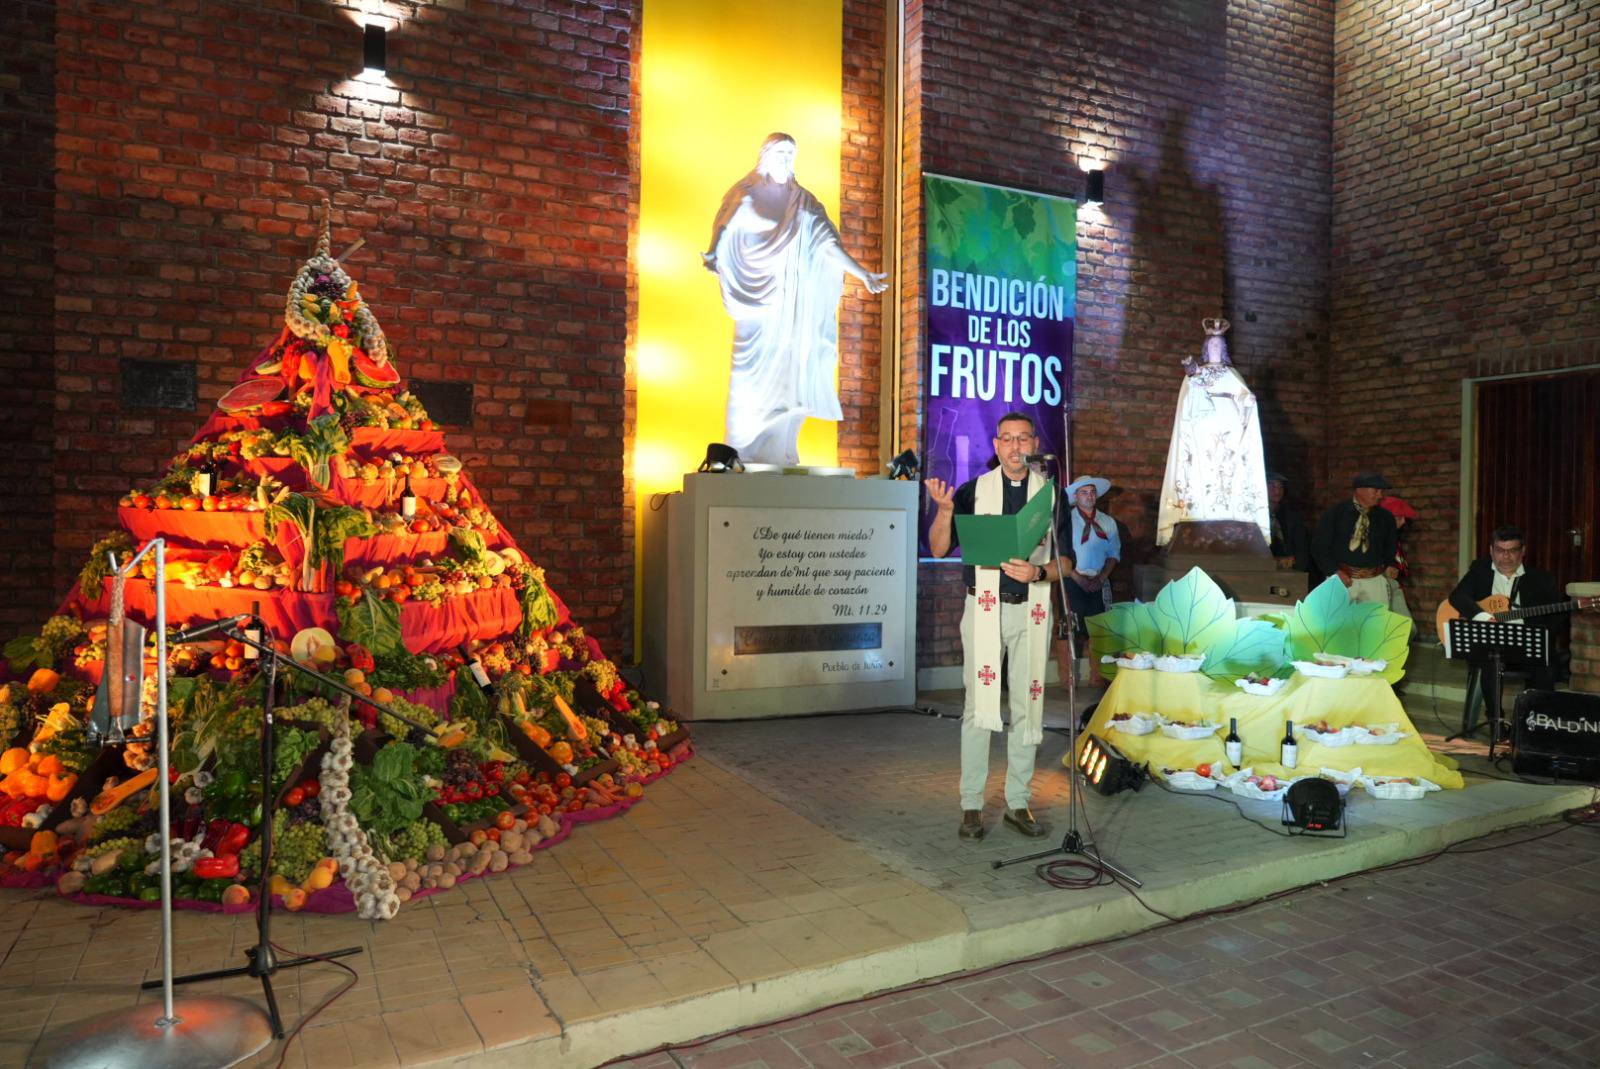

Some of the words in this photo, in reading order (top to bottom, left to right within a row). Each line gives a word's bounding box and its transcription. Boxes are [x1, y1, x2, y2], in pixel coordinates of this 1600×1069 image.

[931, 268, 1065, 322] BENDICIÓN
[967, 314, 992, 344] DE
[996, 318, 1032, 348] LOS
[929, 343, 1063, 407] FRUTOS
[803, 530, 835, 540] tienen
[838, 528, 874, 541] miedo?
[758, 547, 773, 563] Yo
[776, 549, 805, 563] estoy
[807, 551, 827, 559] con
[829, 547, 867, 559] ustedes
[779, 565, 793, 578] de
[812, 569, 831, 581] que
[833, 568, 851, 581] soy
[853, 565, 896, 581] paciente
[756, 588, 764, 601] y
[767, 583, 811, 597] humilde
[813, 584, 826, 596] de
[828, 584, 868, 596] corazón
[858, 604, 888, 617] 11.29
